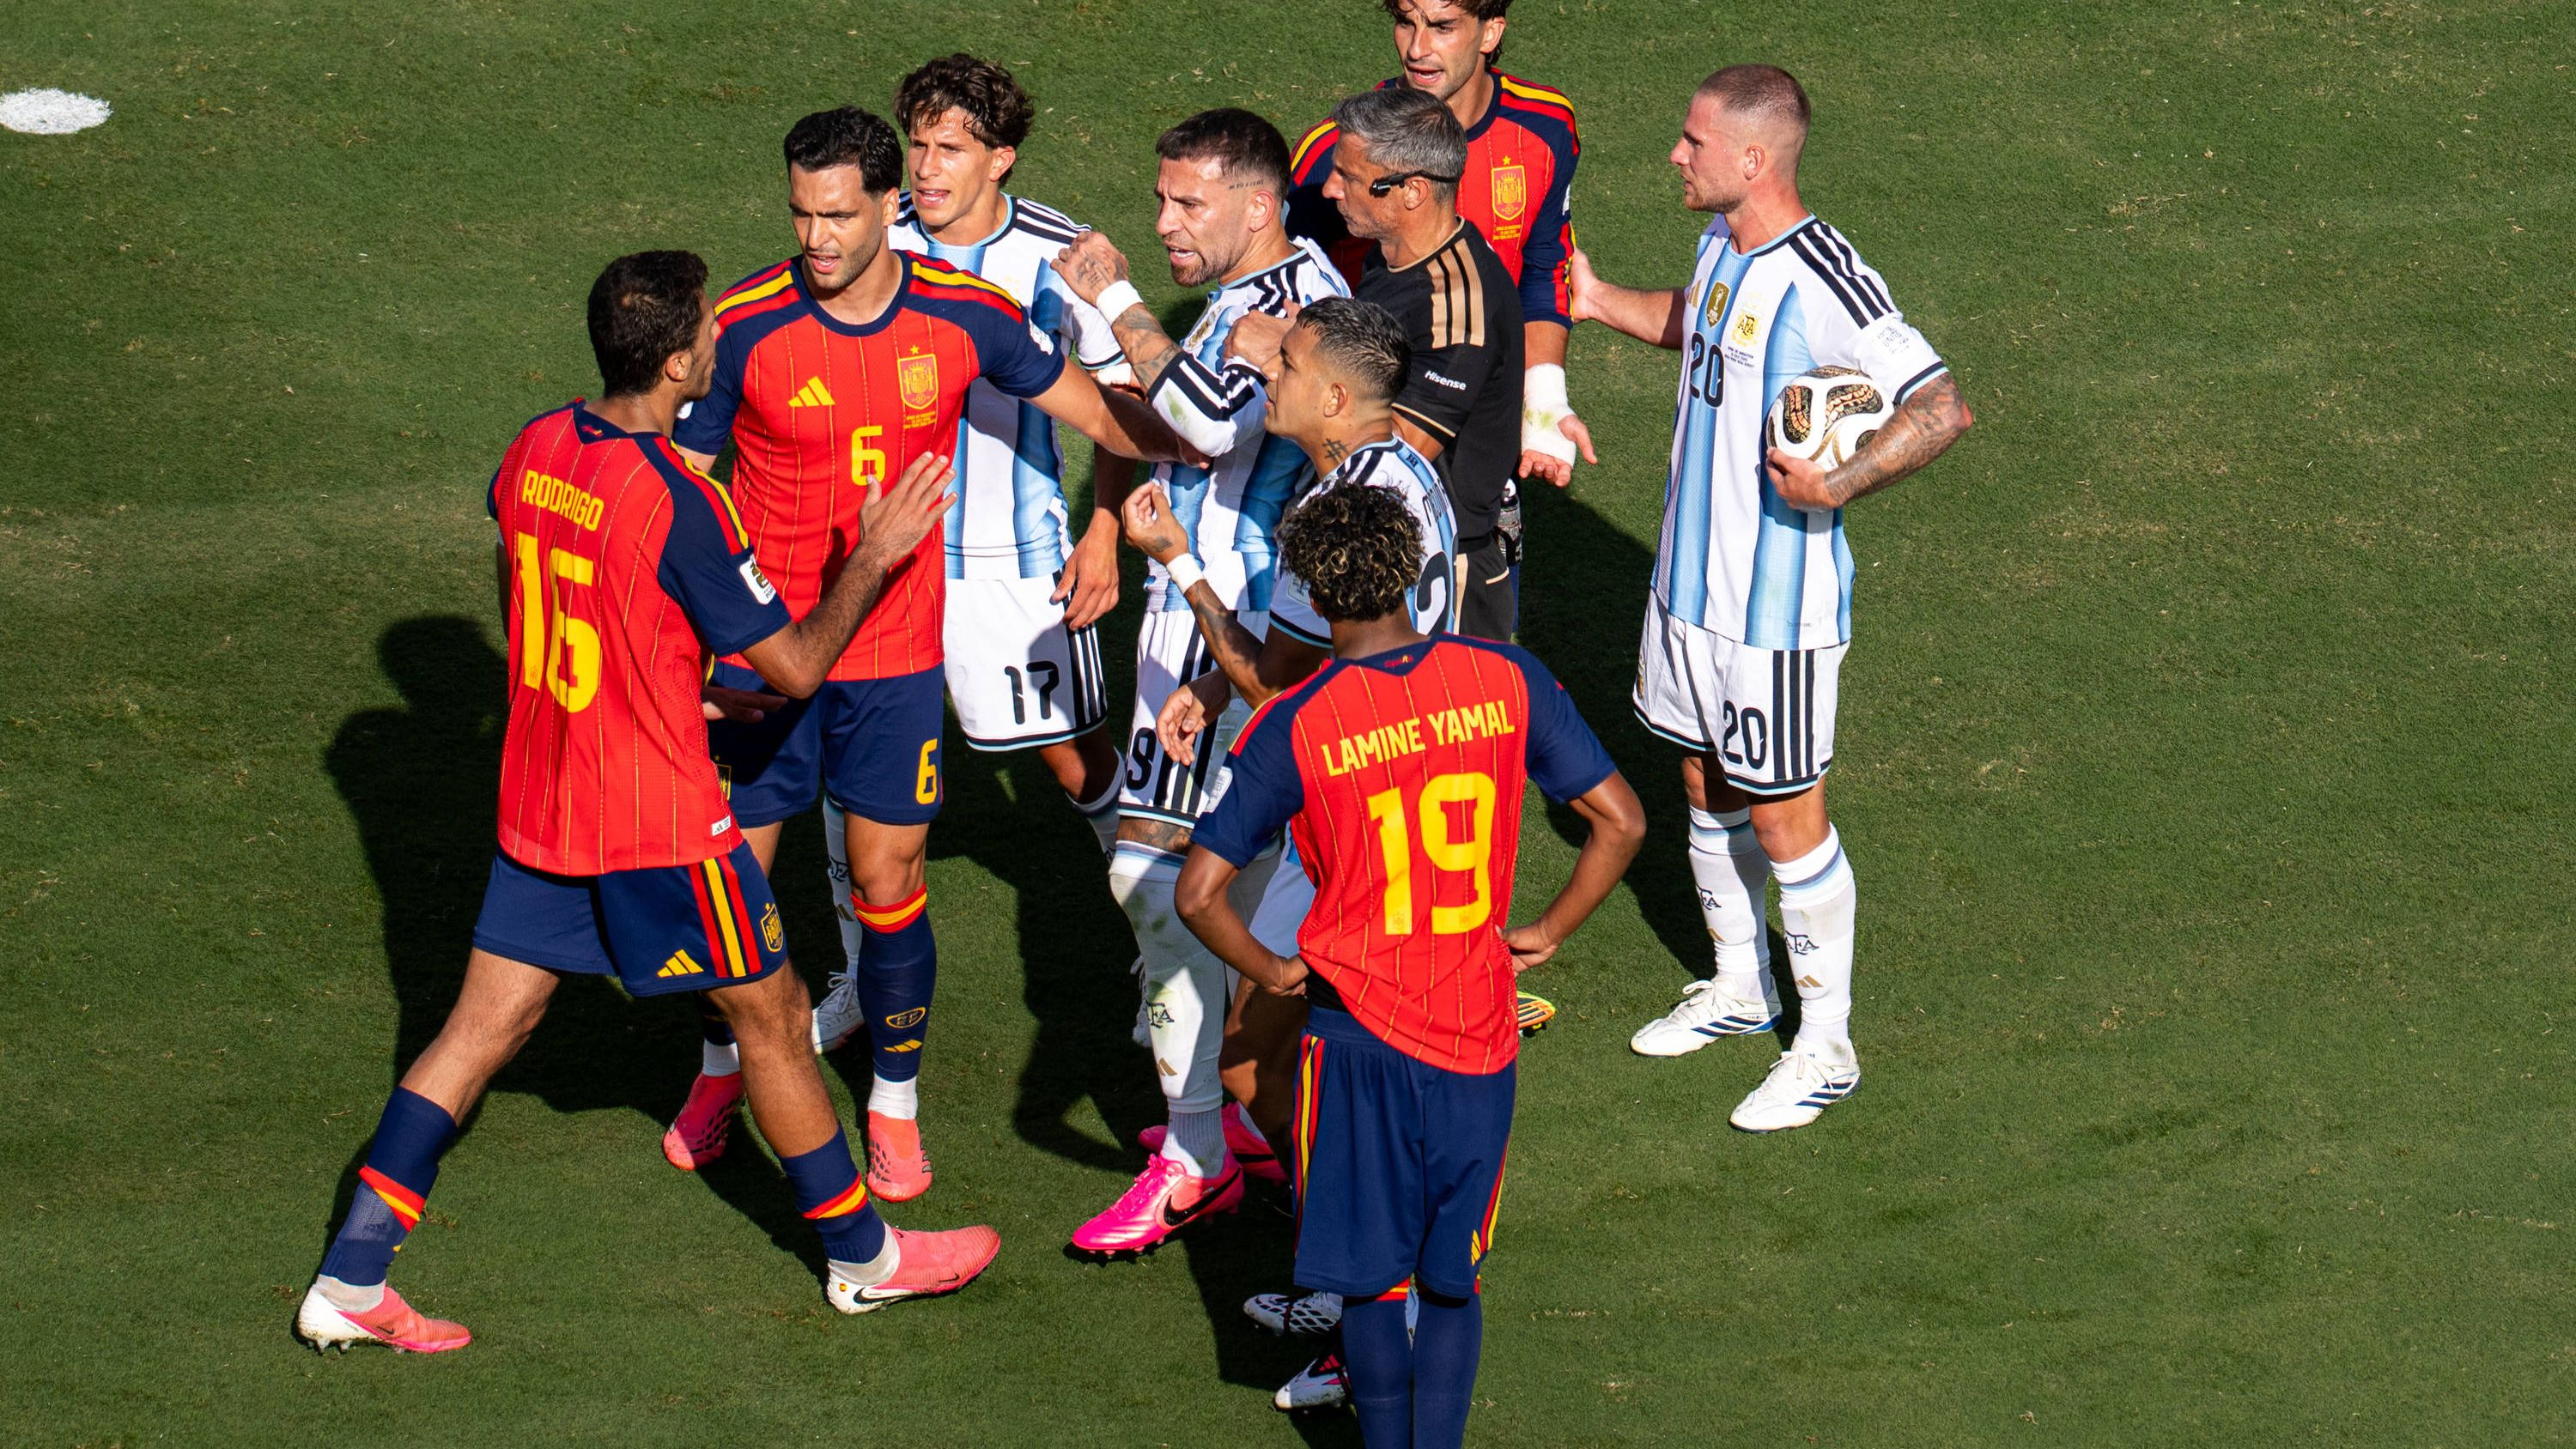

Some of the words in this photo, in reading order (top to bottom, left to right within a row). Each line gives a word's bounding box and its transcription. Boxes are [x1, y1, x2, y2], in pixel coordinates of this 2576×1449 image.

[1425, 370, 1467, 391] Hisense
[1690, 331, 1724, 409] 20
[851, 425, 886, 486] 6
[521, 470, 605, 531] RODRIGO
[518, 530, 601, 713] 16
[1004, 661, 1060, 725] 17
[1321, 718, 1426, 777] LAMINE
[1427, 700, 1516, 746] YAMAL
[1722, 700, 1768, 770] 20
[915, 738, 938, 805] 6
[1367, 772, 1496, 935] 19
